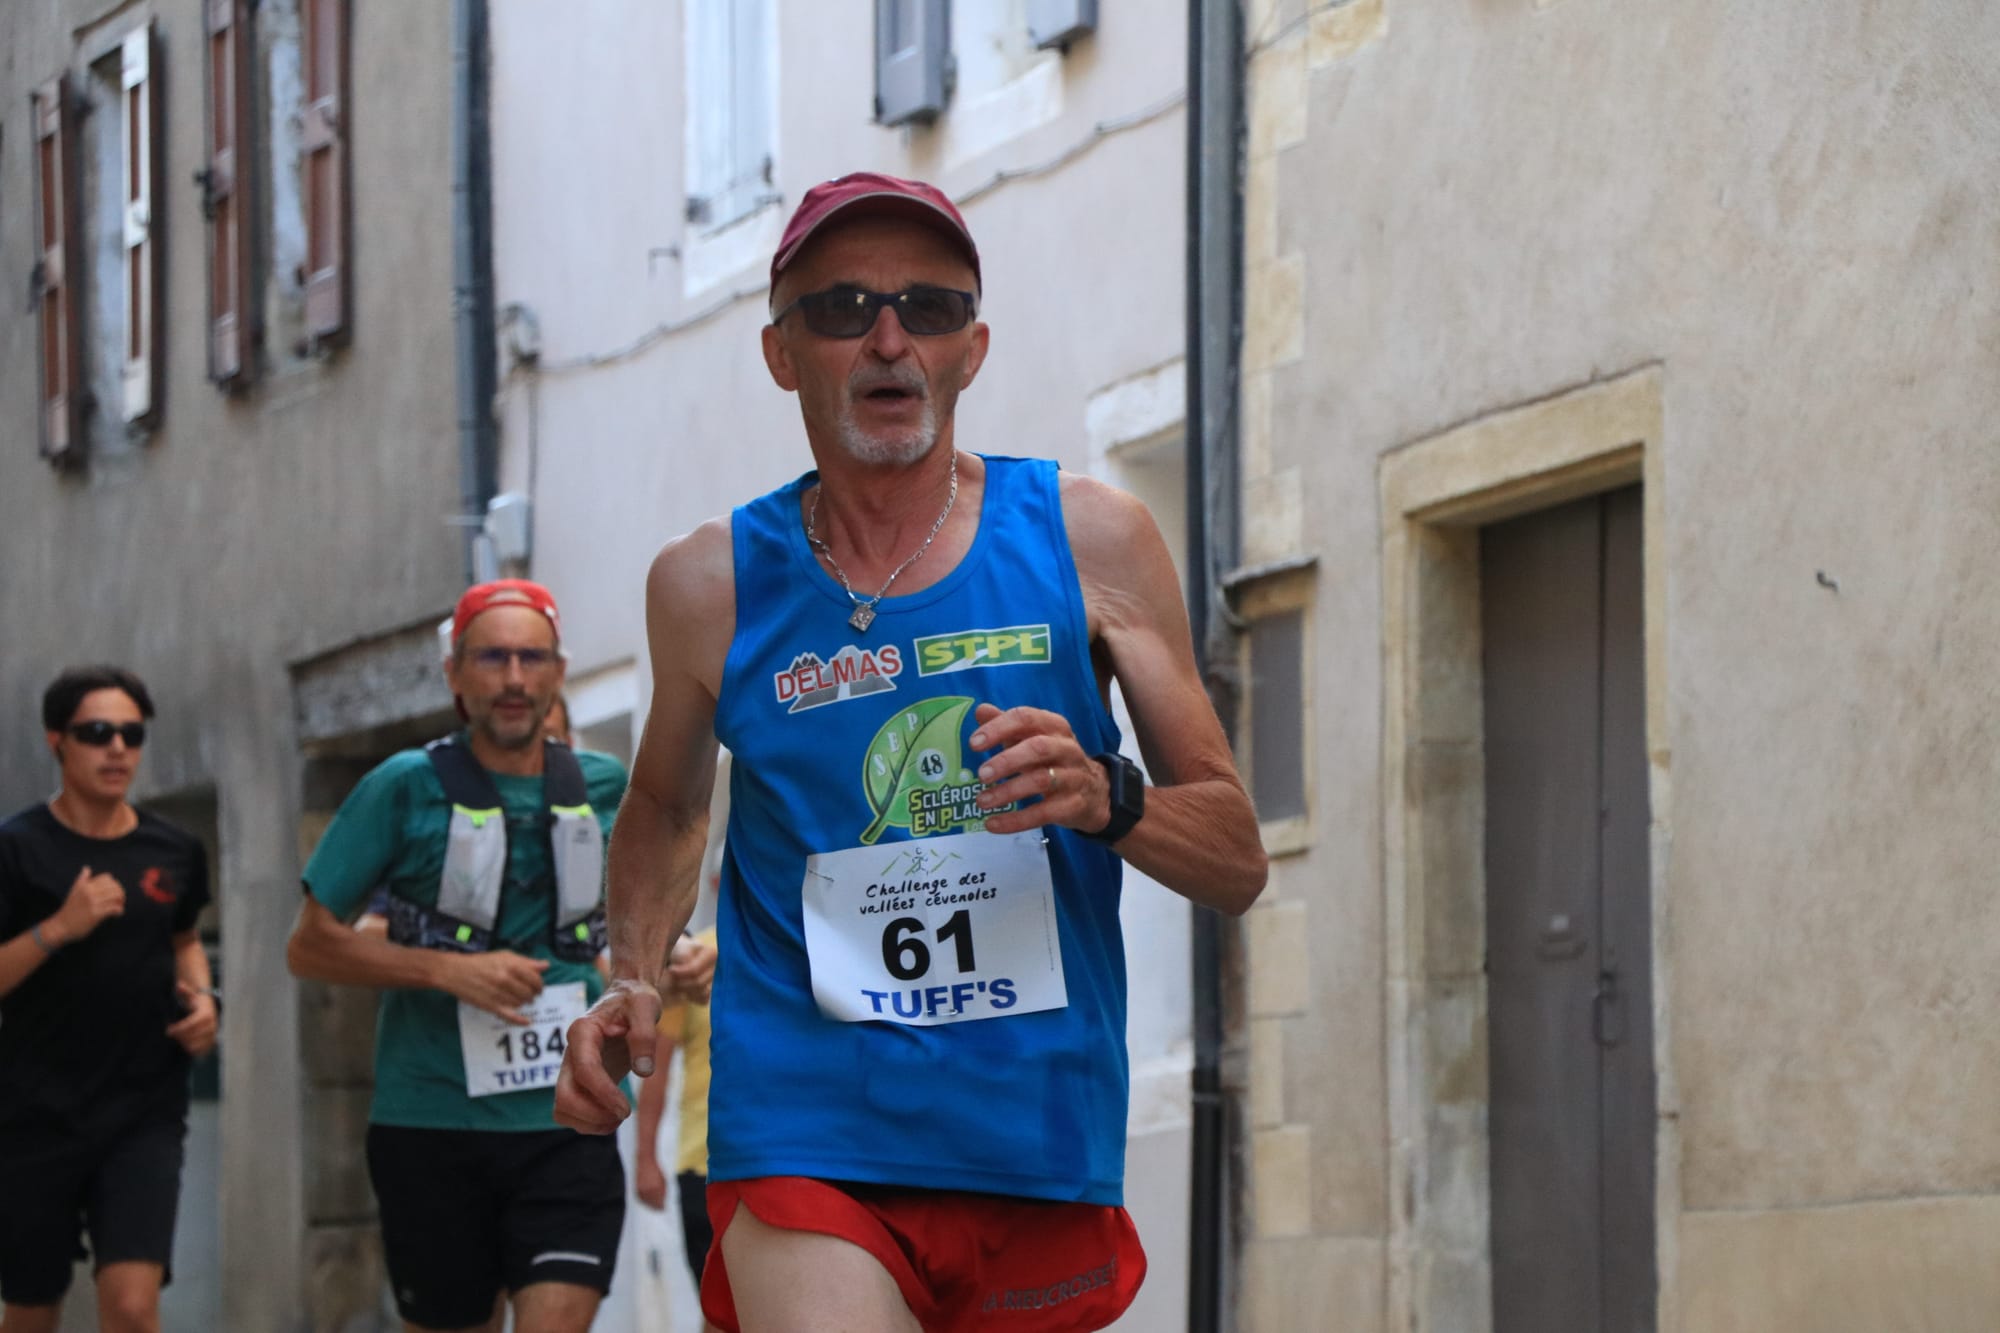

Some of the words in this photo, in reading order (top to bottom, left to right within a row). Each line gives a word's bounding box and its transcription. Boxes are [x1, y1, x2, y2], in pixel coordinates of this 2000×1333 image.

[924, 632, 1045, 666] STPL
[776, 647, 901, 700] DELMAS
[920, 754, 943, 776] 48
[910, 784, 988, 811] SCLÉROS
[914, 811, 936, 832] EN
[865, 878, 948, 898] Challenge
[959, 871, 987, 885] des
[859, 897, 915, 914] vallées
[925, 887, 998, 907] cévenoles
[882, 909, 976, 981] 61
[861, 978, 1018, 1018] TUFF'S
[497, 1027, 564, 1064] 184
